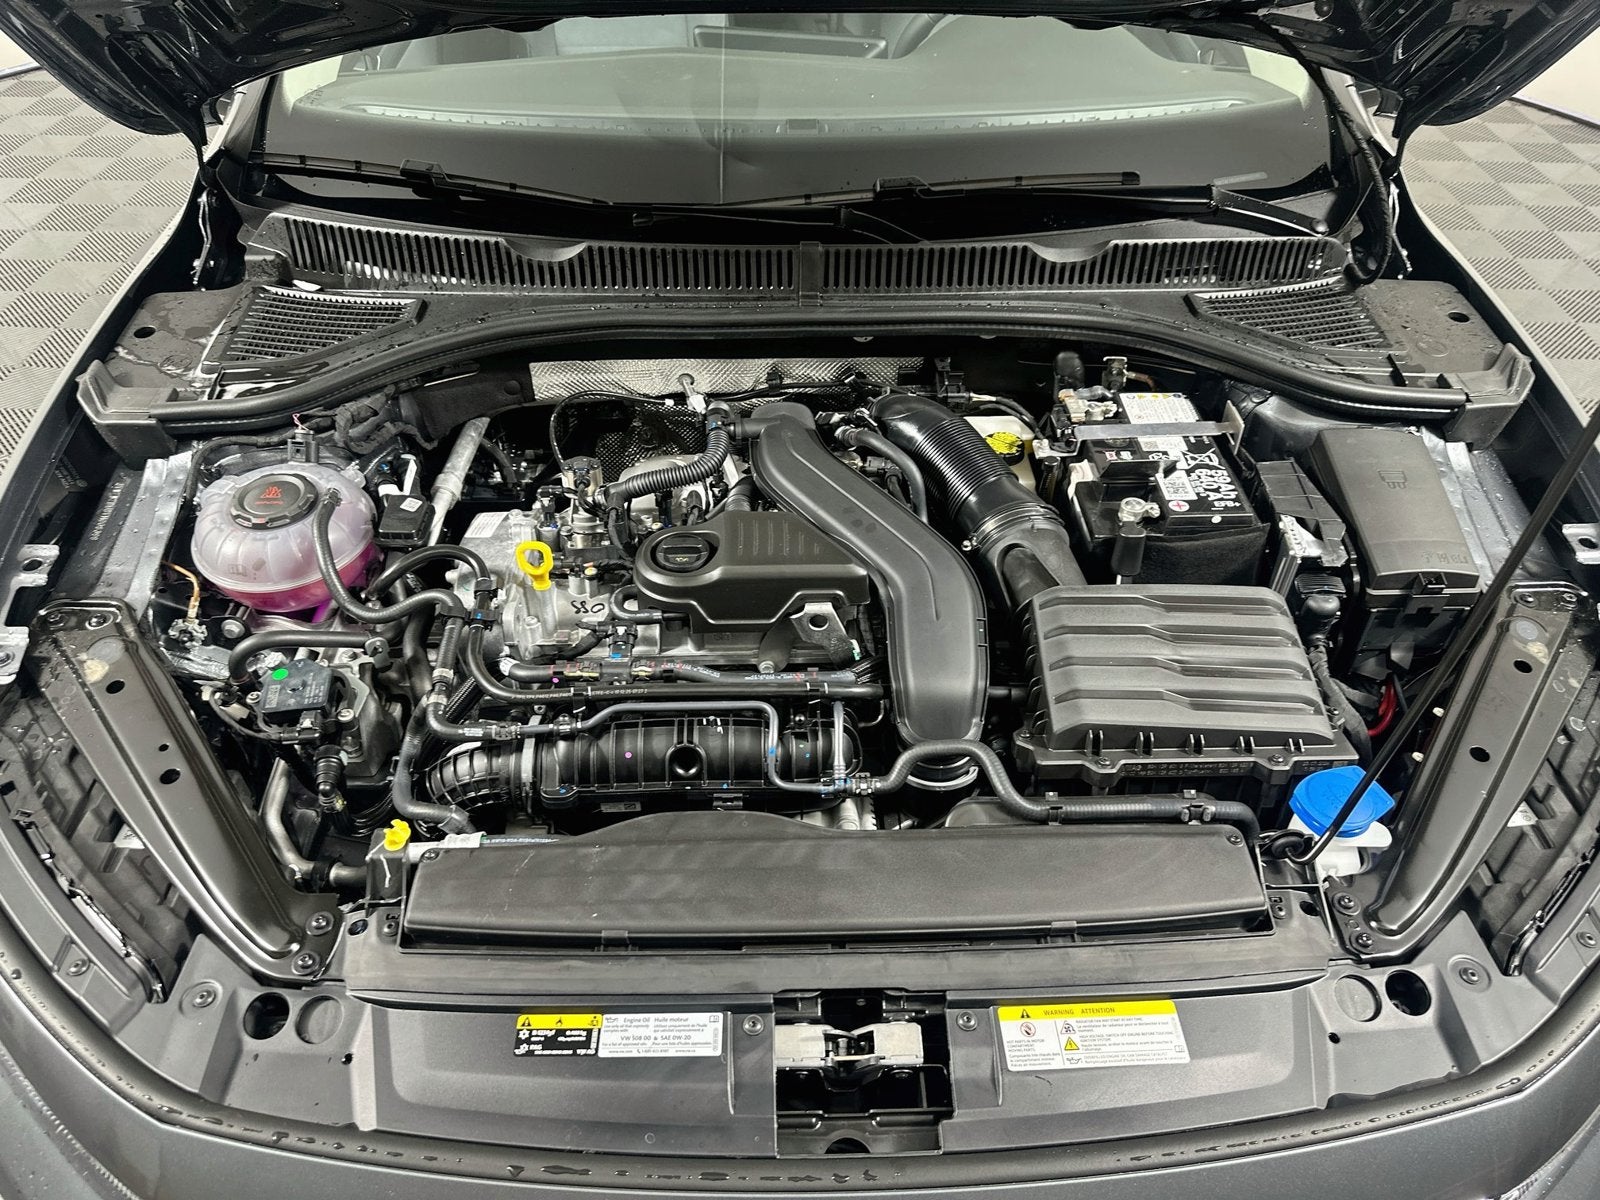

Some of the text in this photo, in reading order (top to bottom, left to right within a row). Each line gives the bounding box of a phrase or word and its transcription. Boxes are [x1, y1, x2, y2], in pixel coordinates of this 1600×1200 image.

[1194, 468, 1219, 489] 640
[1211, 469, 1238, 499] 59Ah
[1043, 1006, 1116, 1016] WARNING ATTENTION
